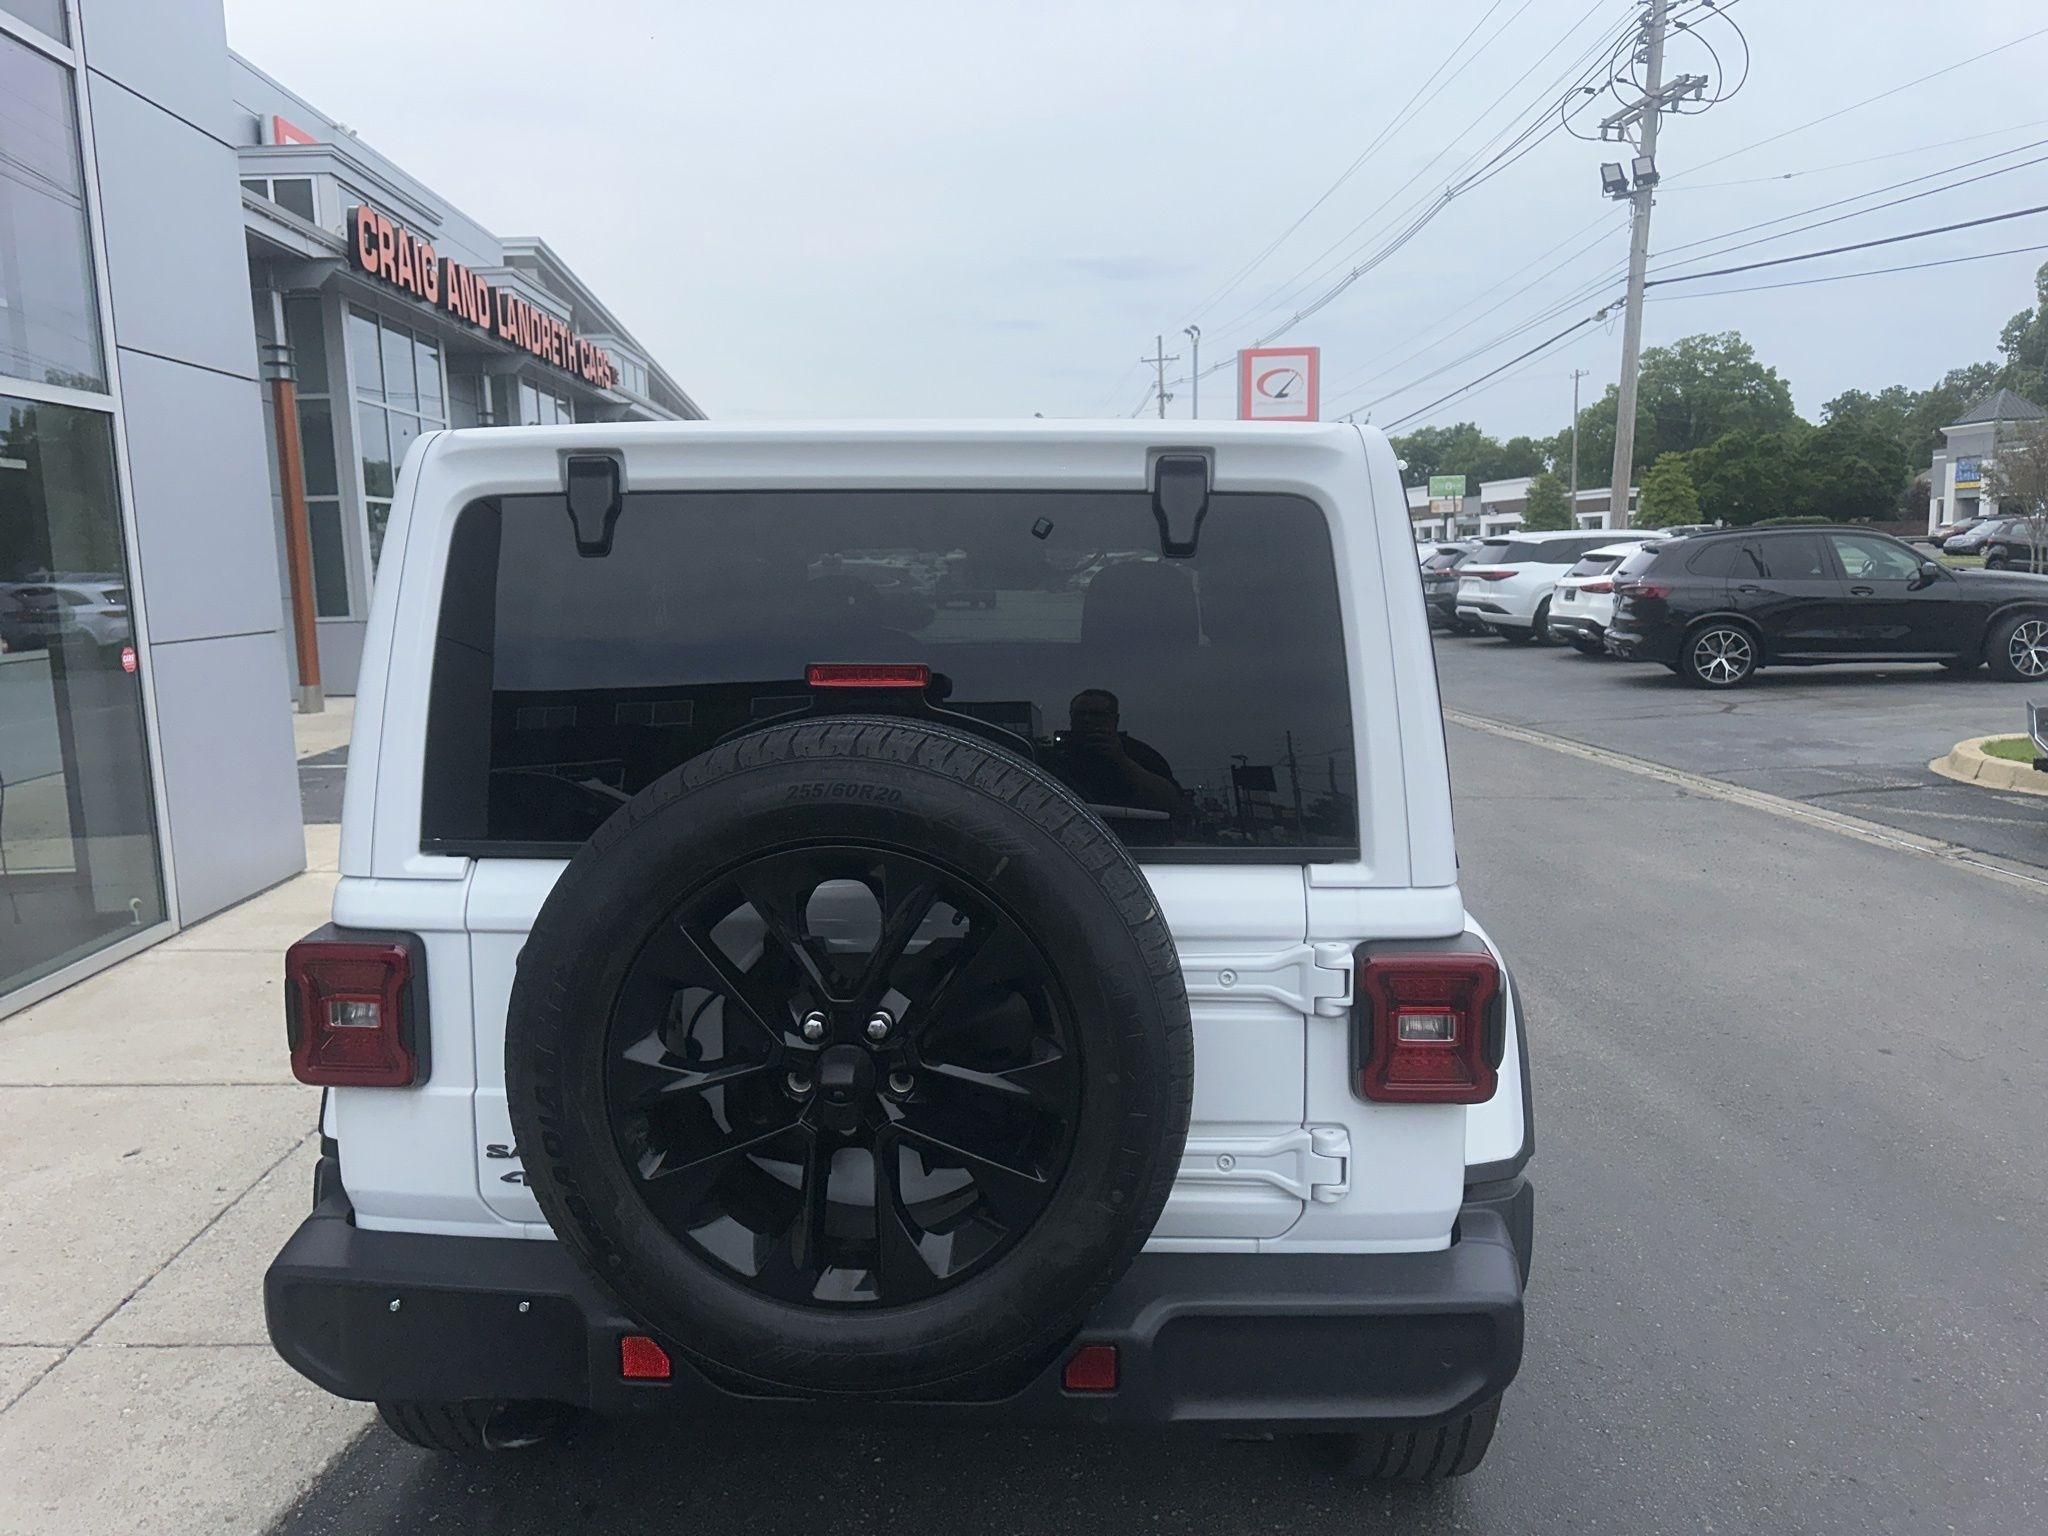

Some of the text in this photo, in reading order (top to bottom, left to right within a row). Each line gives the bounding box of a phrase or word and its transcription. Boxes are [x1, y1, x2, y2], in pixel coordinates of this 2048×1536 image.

[356, 204, 612, 390] CRAIG AND LANDRETH CARS
[787, 782, 902, 802] 255/60R20
